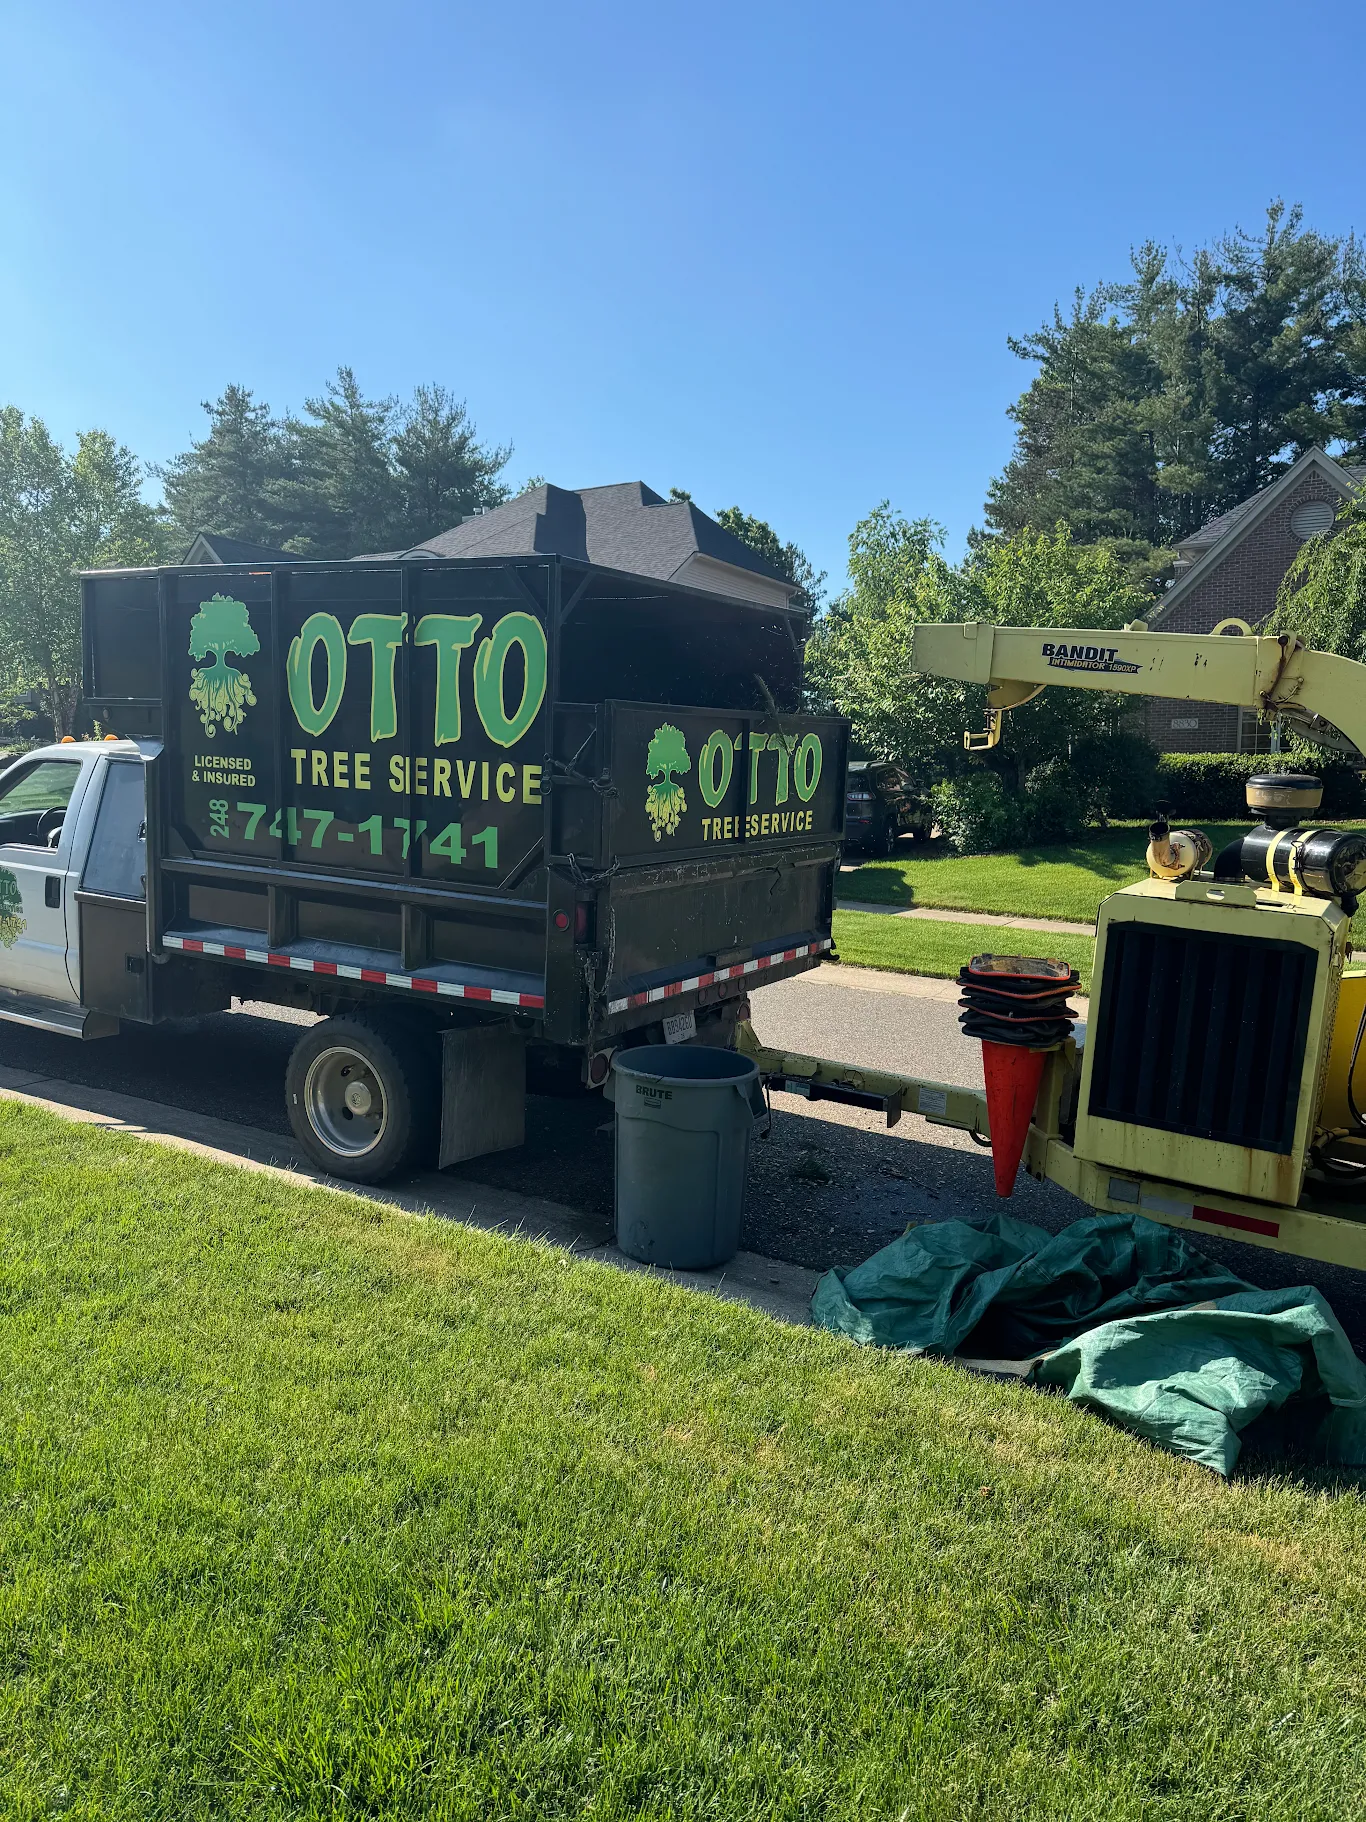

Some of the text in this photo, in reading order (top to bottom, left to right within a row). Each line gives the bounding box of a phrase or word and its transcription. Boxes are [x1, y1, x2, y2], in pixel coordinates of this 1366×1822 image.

[1042, 643, 1118, 662] BANDIT
[1051, 658, 1137, 673] INTIMIDATOR 1590XP
[287, 612, 547, 748] OTTO
[194, 755, 251, 771] LICENSED
[699, 729, 823, 808] OTTO
[192, 770, 256, 787] & INSURED
[291, 748, 543, 805] TREE SERVICE
[209, 799, 499, 869] 248 747-1741
[702, 810, 813, 841] TREE SERVICE
[636, 1084, 673, 1100] BRUTE
